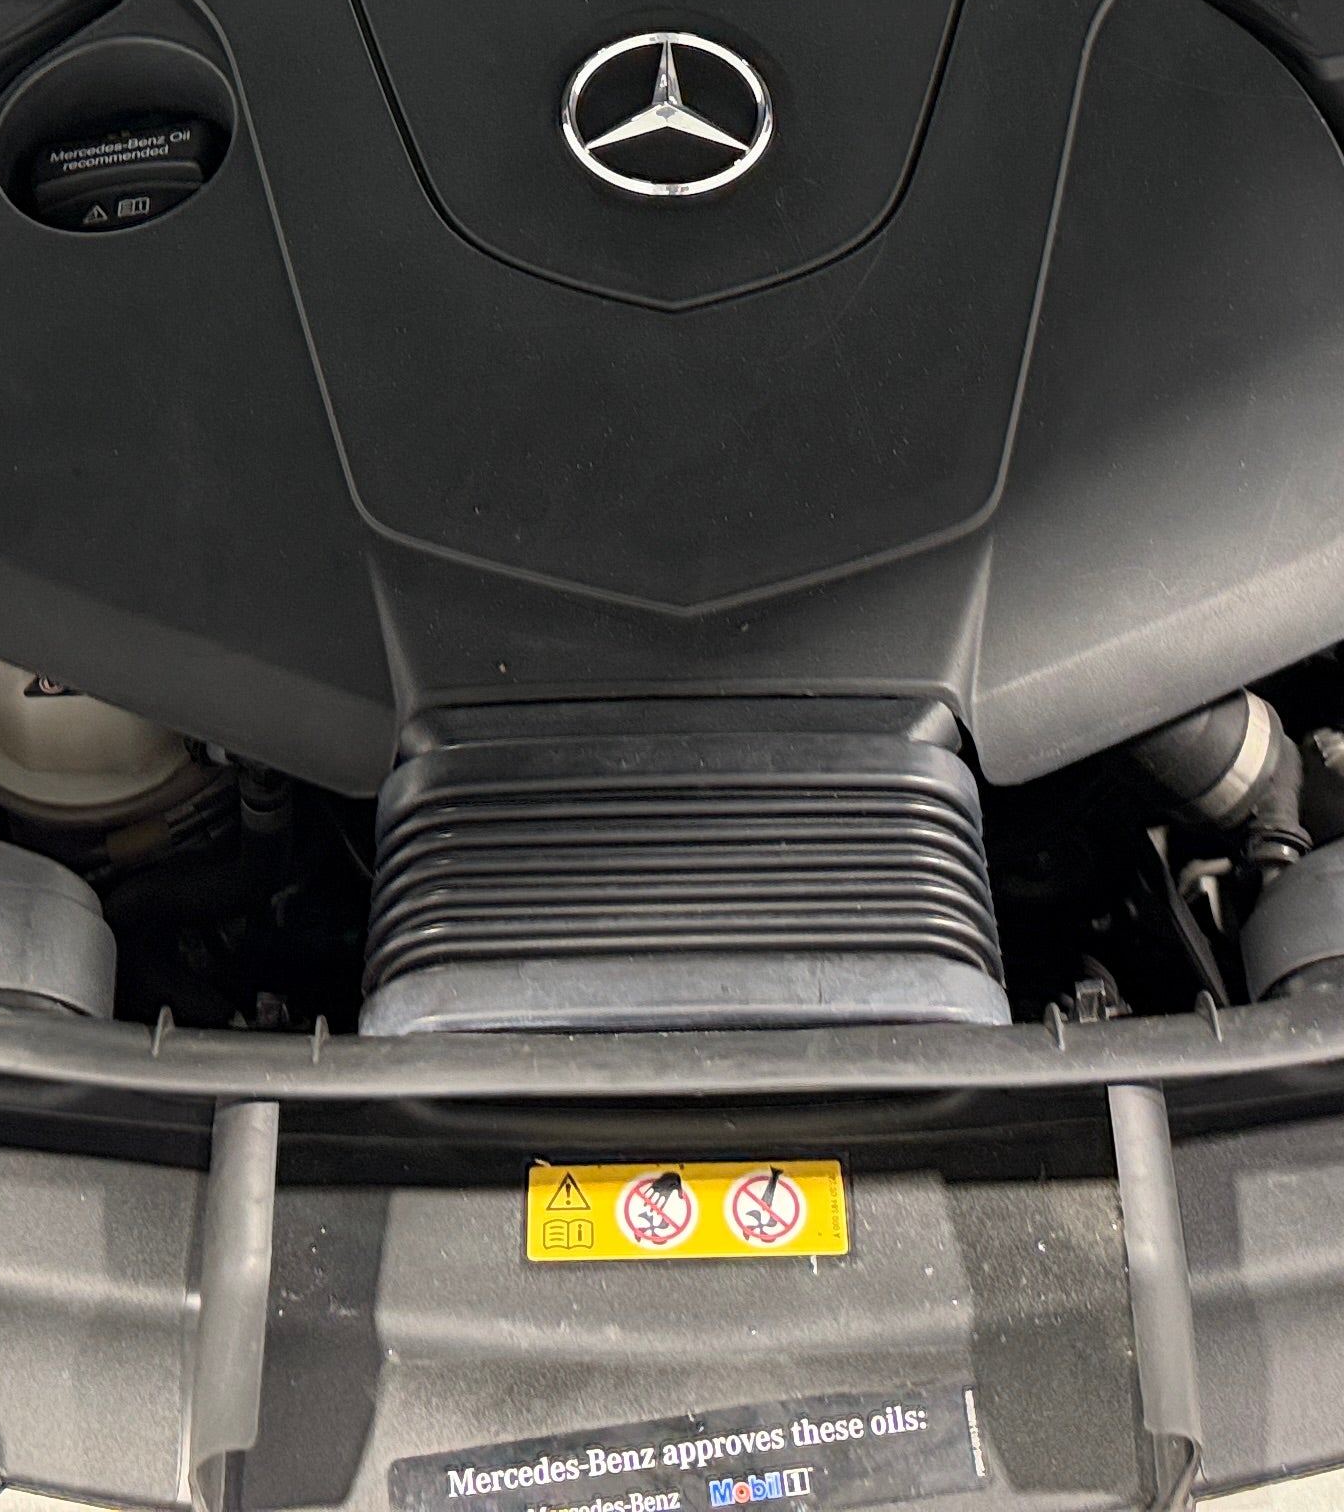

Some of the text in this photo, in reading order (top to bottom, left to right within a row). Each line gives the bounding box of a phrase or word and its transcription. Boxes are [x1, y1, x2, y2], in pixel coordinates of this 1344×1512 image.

[50, 129, 191, 163] Mercedes-Benz Oil
[62, 144, 169, 172] recommended
[447, 1446, 656, 1498] Mercedes-Benz
[662, 1427, 786, 1470] approves
[790, 1417, 865, 1447] these
[870, 1405, 928, 1436] oils:
[527, 1492, 681, 1512] des-Benz
[709, 1471, 783, 1506] Mobil
